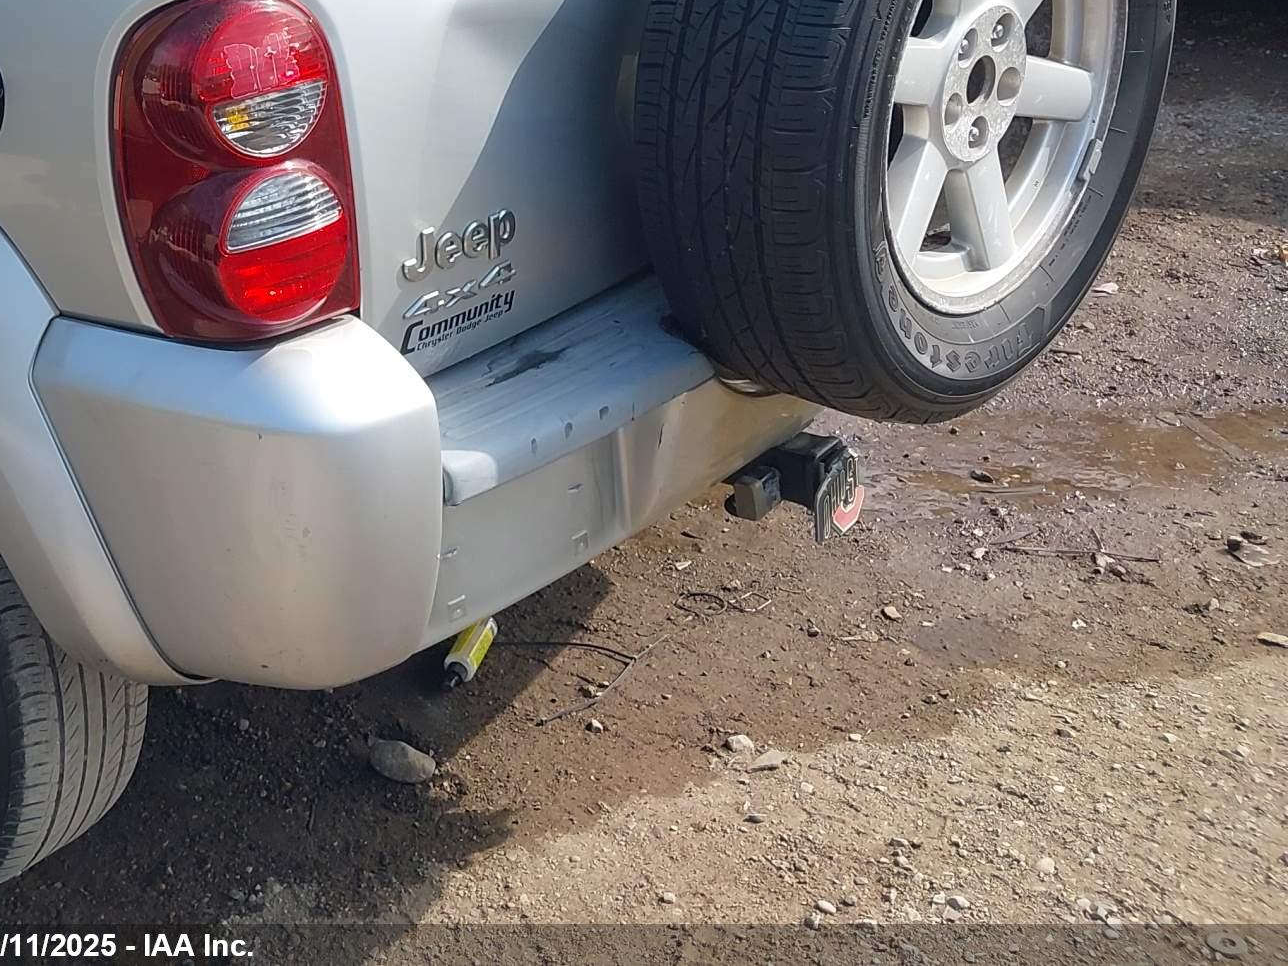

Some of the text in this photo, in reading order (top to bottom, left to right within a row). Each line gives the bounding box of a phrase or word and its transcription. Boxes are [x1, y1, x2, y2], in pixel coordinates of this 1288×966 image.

[402, 209, 515, 282] Jeep
[400, 290, 515, 355] Community
[417, 309, 503, 351] Chrysler Dodge Jeep
[888, 286, 1033, 373] Firestone
